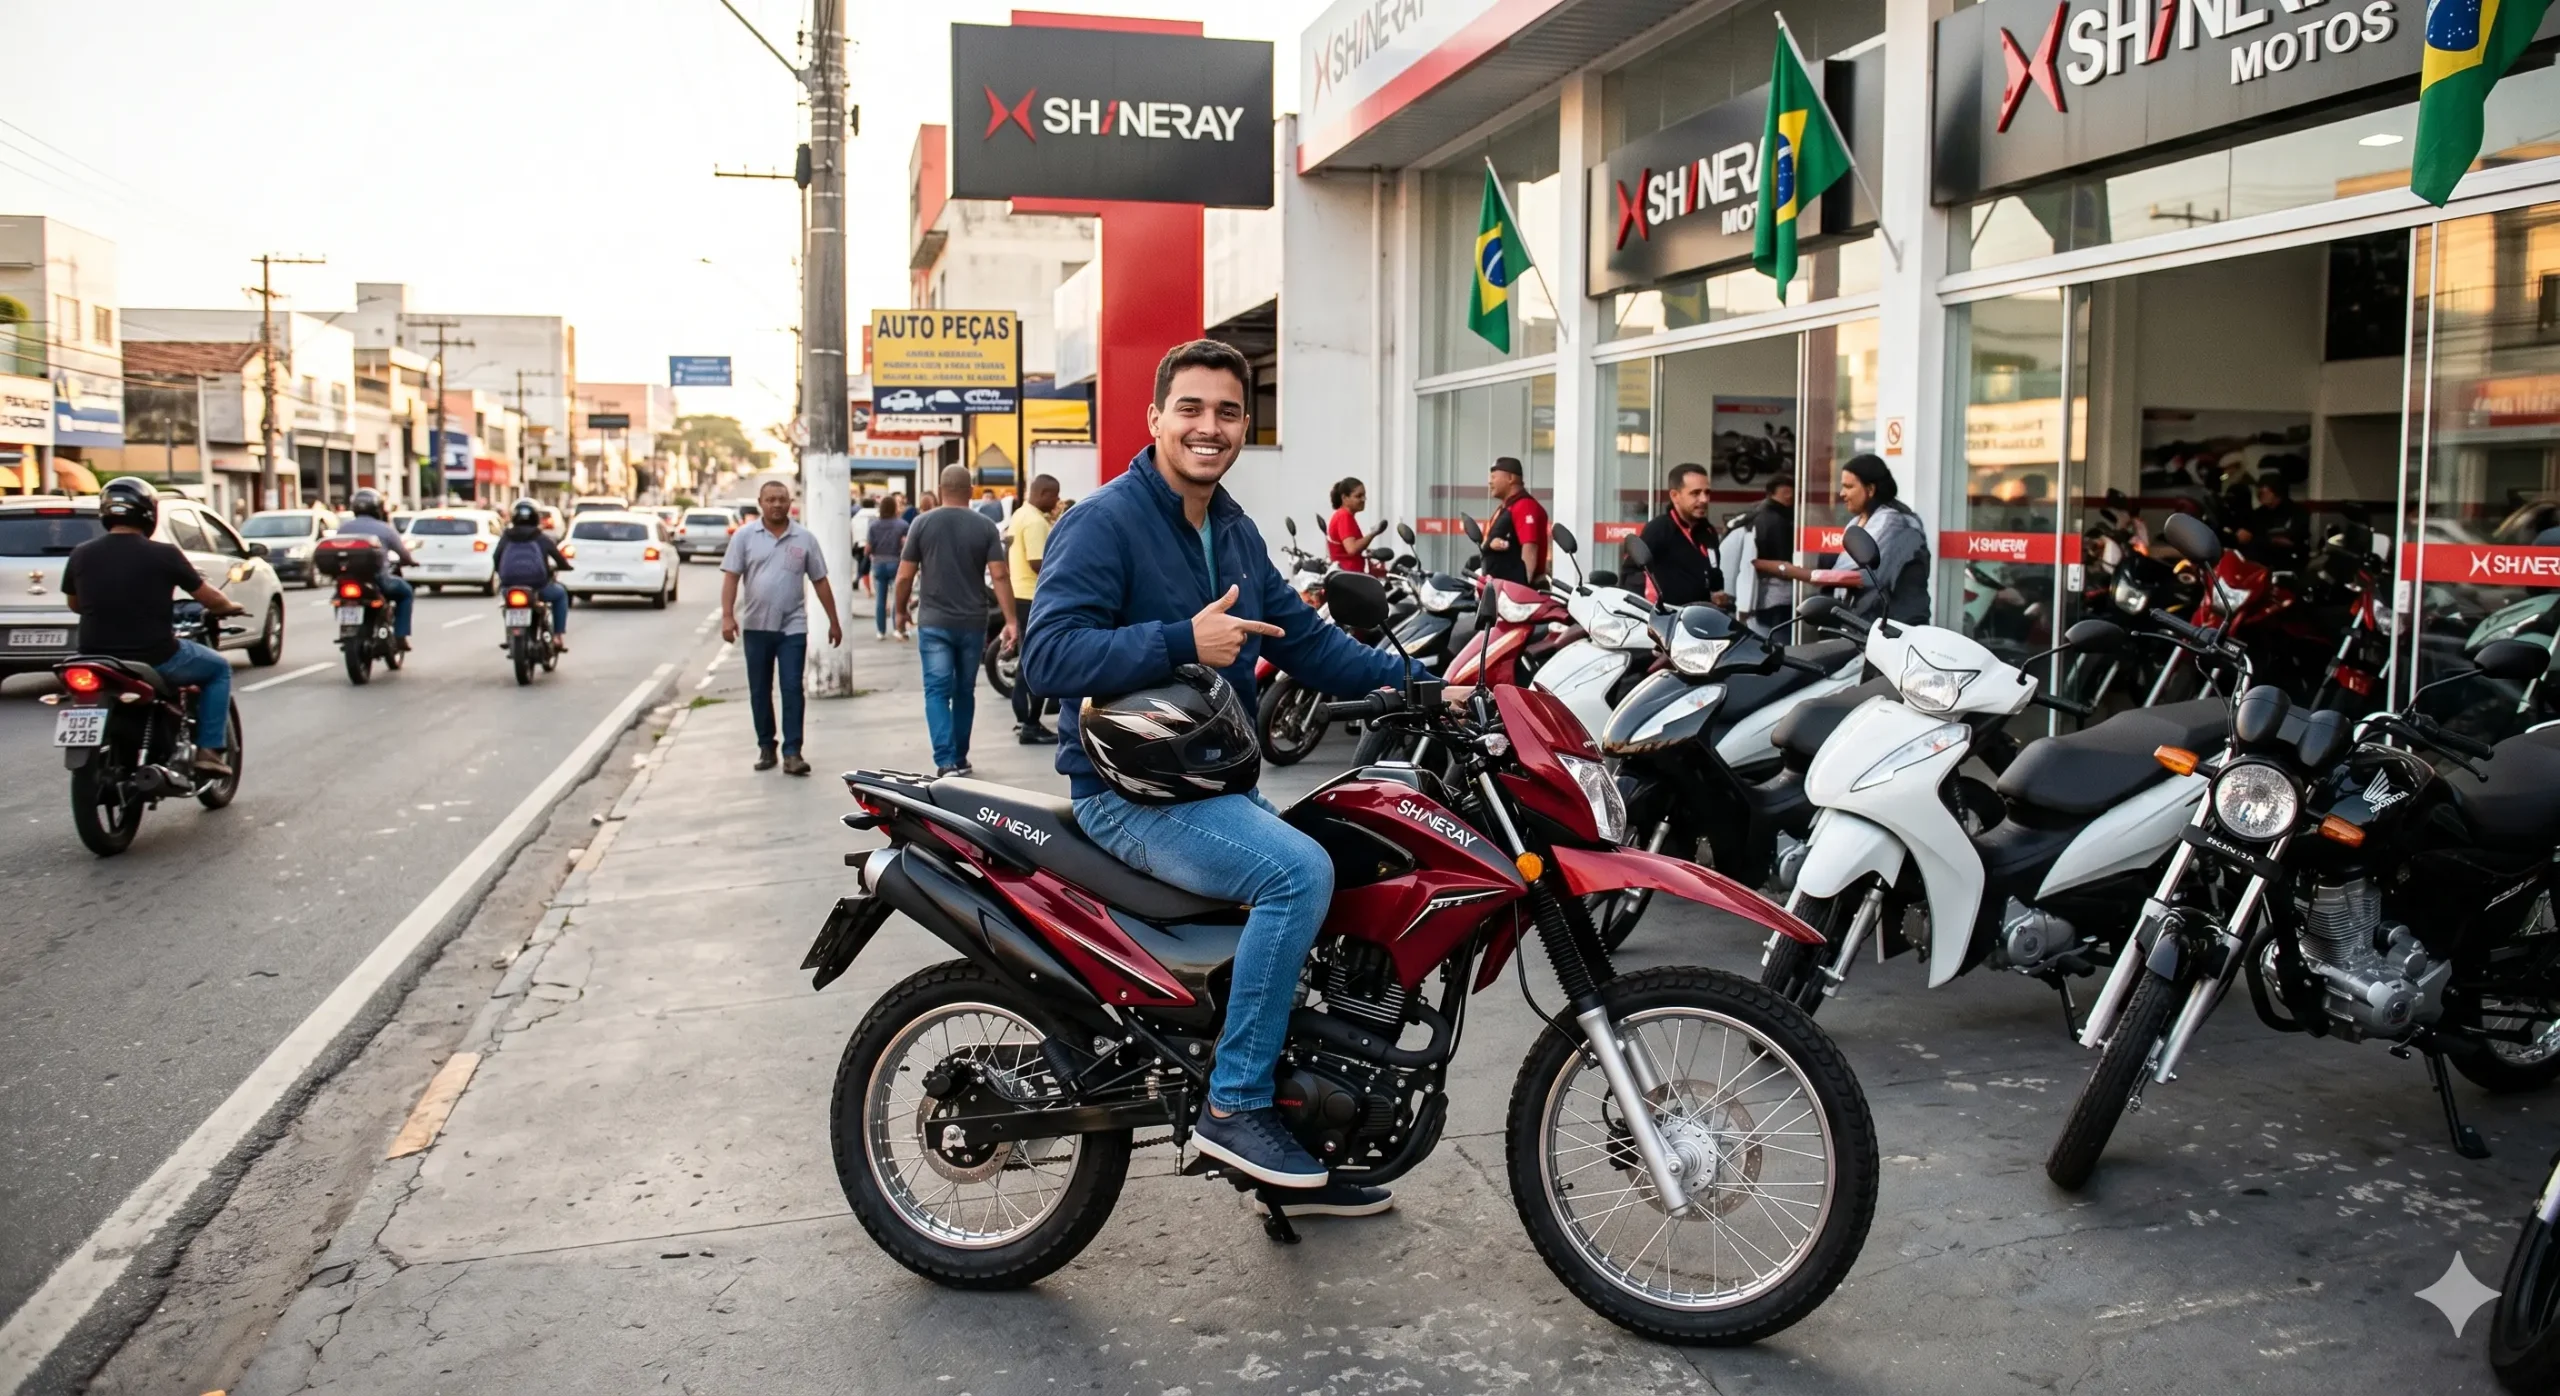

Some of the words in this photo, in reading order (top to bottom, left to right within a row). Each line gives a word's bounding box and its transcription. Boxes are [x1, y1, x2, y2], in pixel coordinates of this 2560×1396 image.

[2230, 1, 2396, 84] MOTOS
[1043, 97, 1244, 141] SHINERAY
[878, 315, 934, 339] AUTO
[942, 316, 1009, 346] PEÇAS
[976, 806, 1052, 847] SHINERAY
[1397, 799, 1478, 848] SHINERAY
